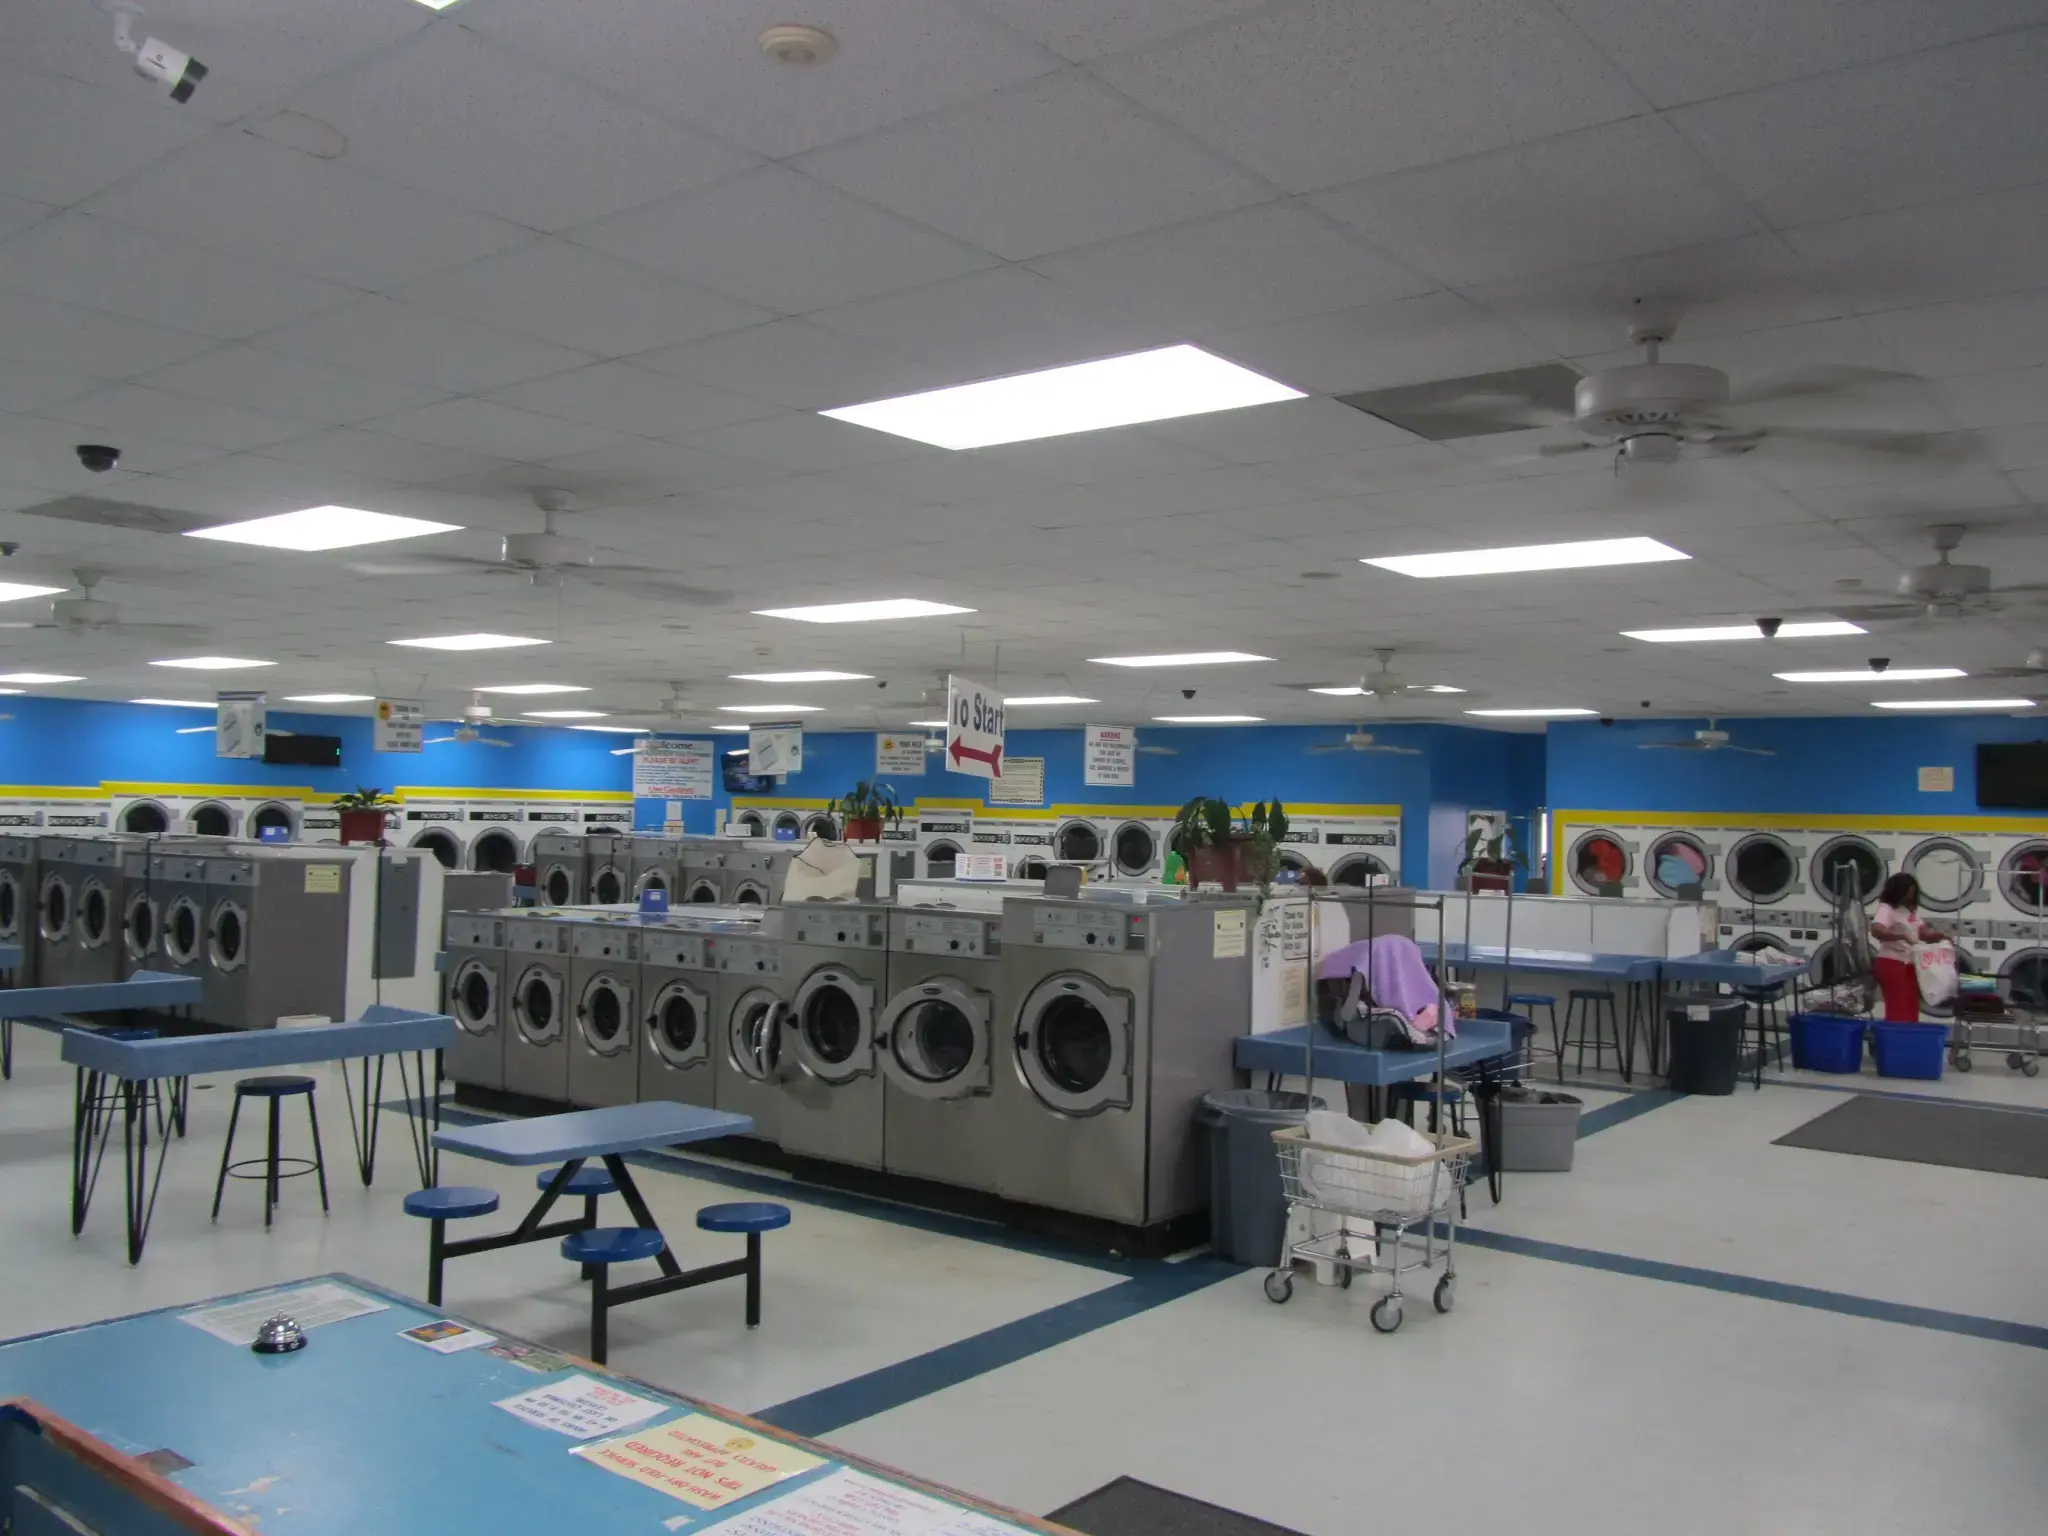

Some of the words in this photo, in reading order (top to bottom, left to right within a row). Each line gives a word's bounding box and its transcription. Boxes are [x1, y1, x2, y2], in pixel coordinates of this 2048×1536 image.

[974, 692, 1004, 738] Start
[666, 1430, 731, 1456] APPRECIATED
[598, 1448, 638, 1468] SERVICE
[624, 1440, 682, 1468] REQUIRED
[682, 1448, 702, 1459] ARE
[703, 1458, 728, 1468] BUT
[682, 1465, 715, 1479] NOT
[732, 1454, 777, 1473] GREATLY
[712, 1476, 744, 1490] TIPS
